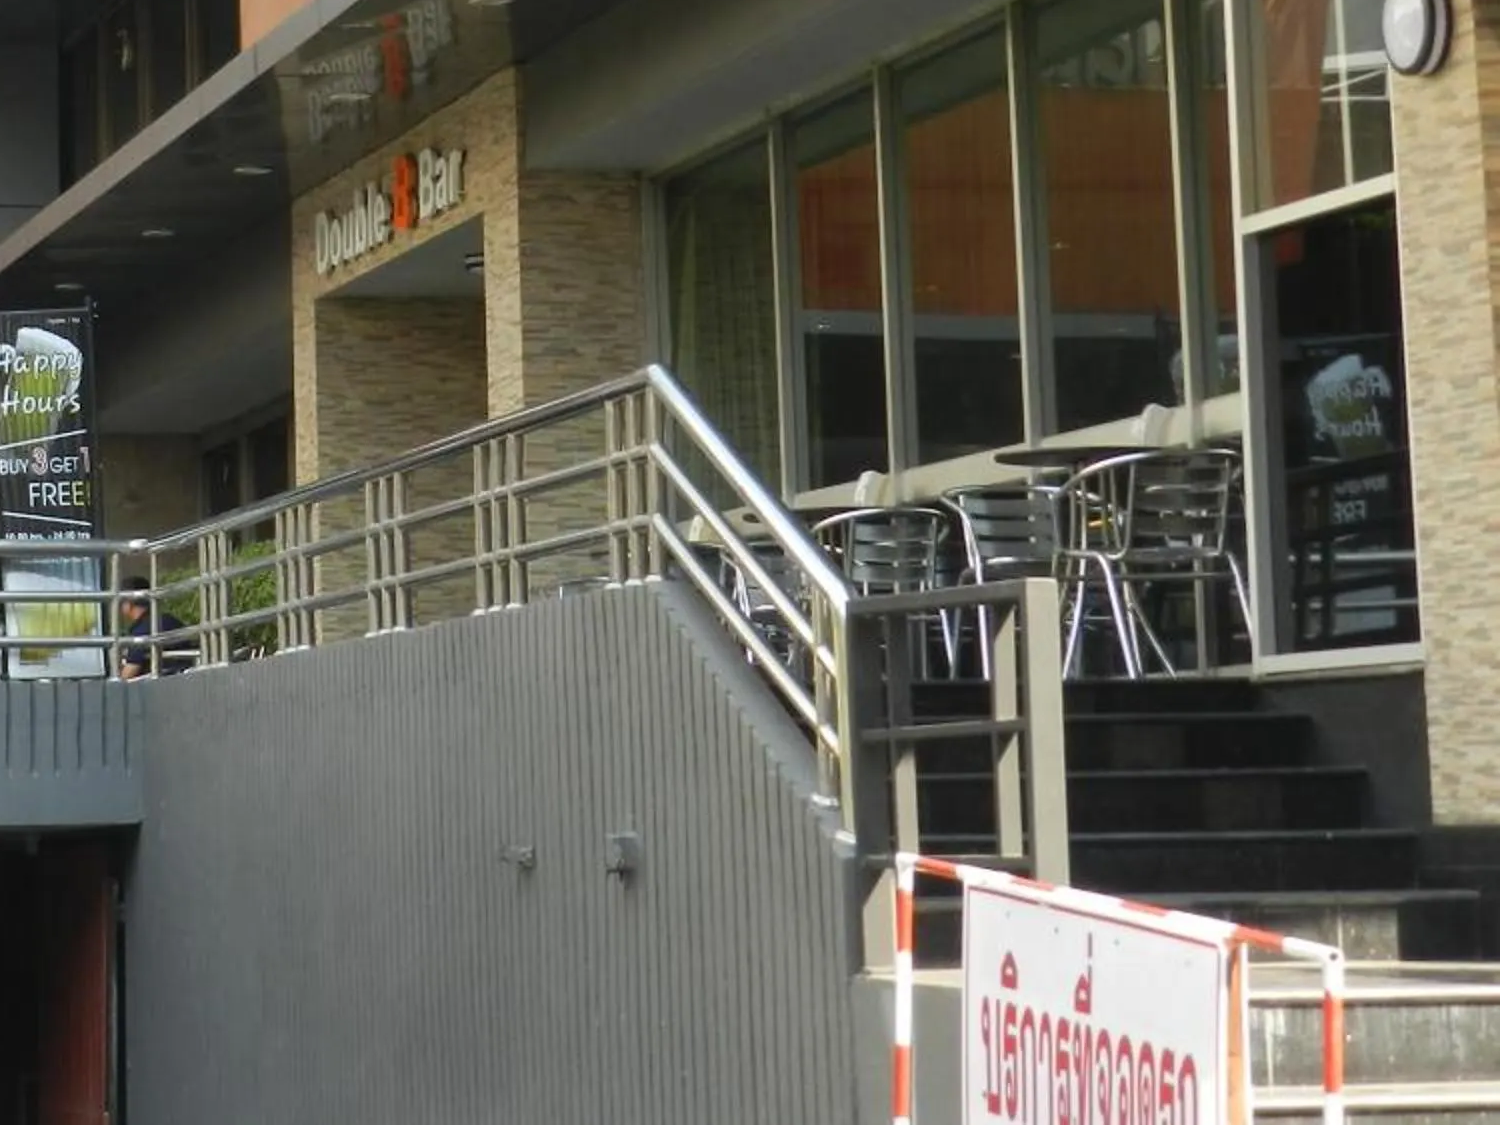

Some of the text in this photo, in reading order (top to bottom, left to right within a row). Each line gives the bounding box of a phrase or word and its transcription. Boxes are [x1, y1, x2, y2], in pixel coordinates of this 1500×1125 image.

[314, 181, 388, 275] Double
[418, 148, 465, 221] Bar
[1, 384, 81, 417] Hours
[0, 458, 29, 475] BUY
[31, 446, 49, 475] 3
[50, 456, 79, 474] GET
